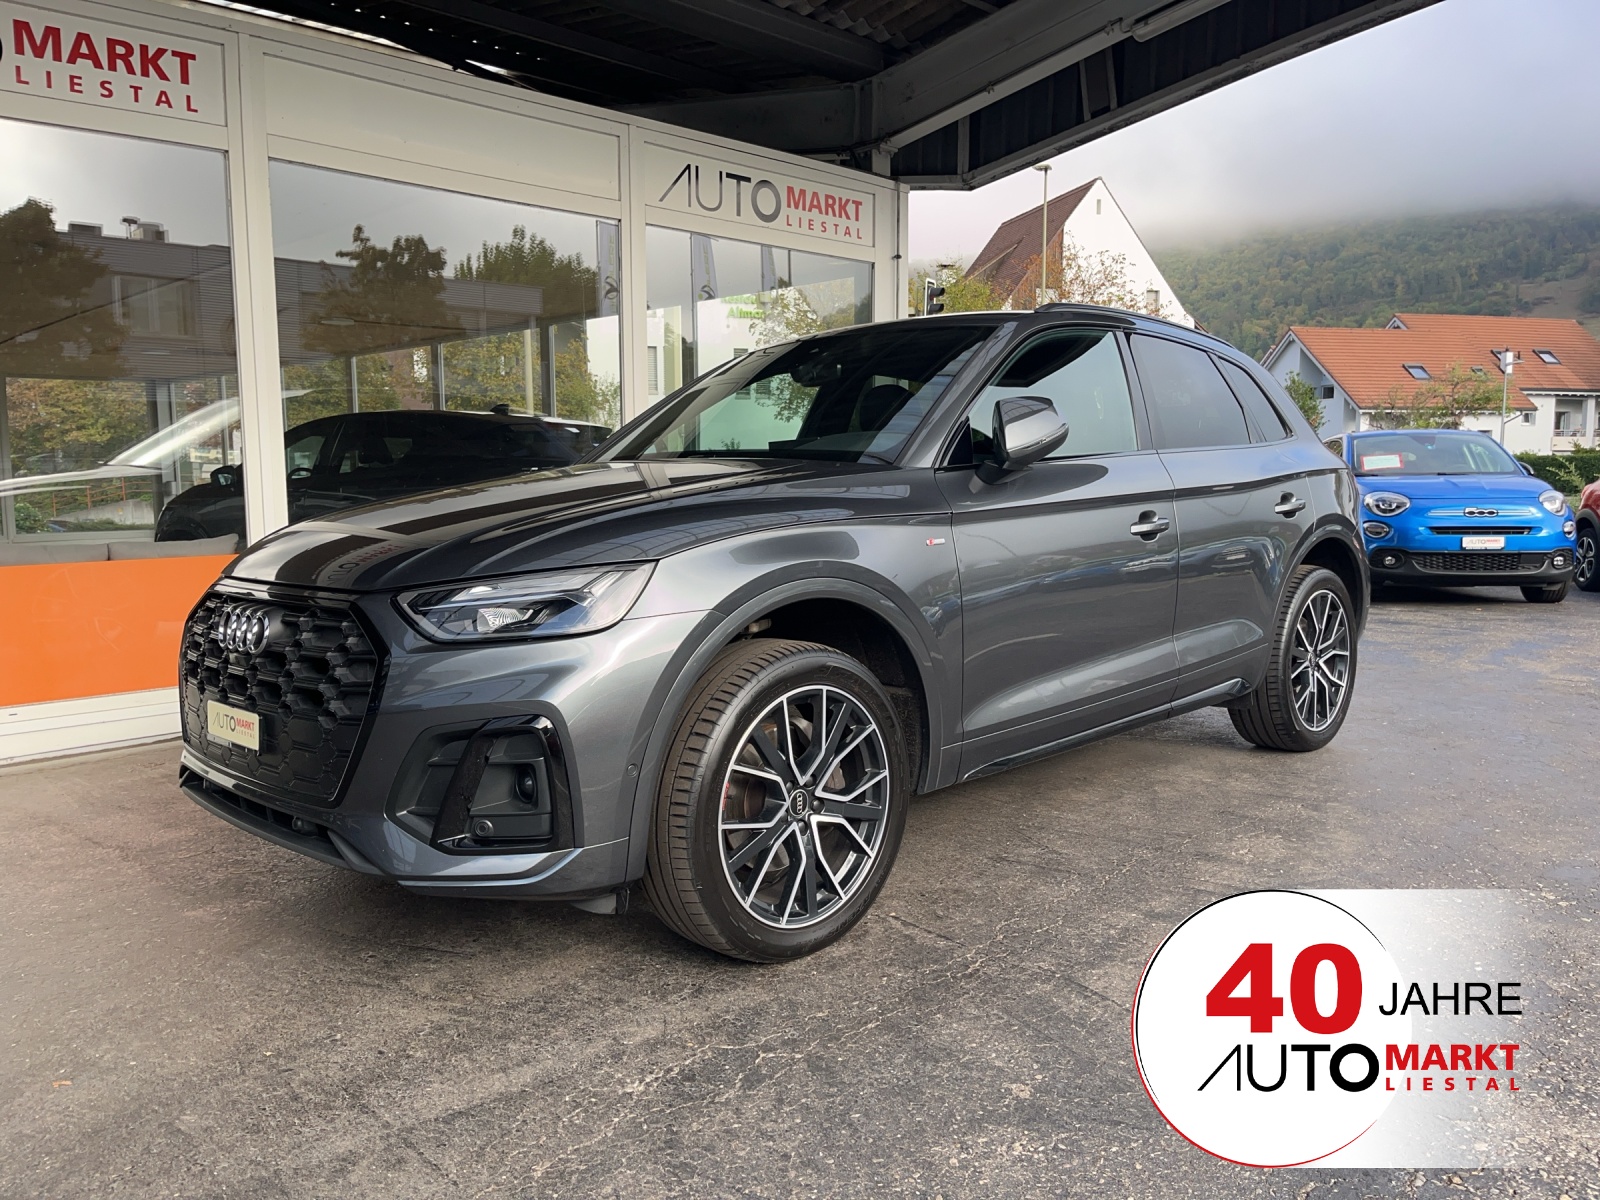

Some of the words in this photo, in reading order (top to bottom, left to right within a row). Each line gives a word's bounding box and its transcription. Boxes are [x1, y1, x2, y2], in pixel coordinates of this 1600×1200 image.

[12, 18, 197, 86] MARKT
[14, 65, 199, 113] LIESTAL
[786, 185, 863, 222] MARKT
[786, 214, 863, 240] LIESTAL
